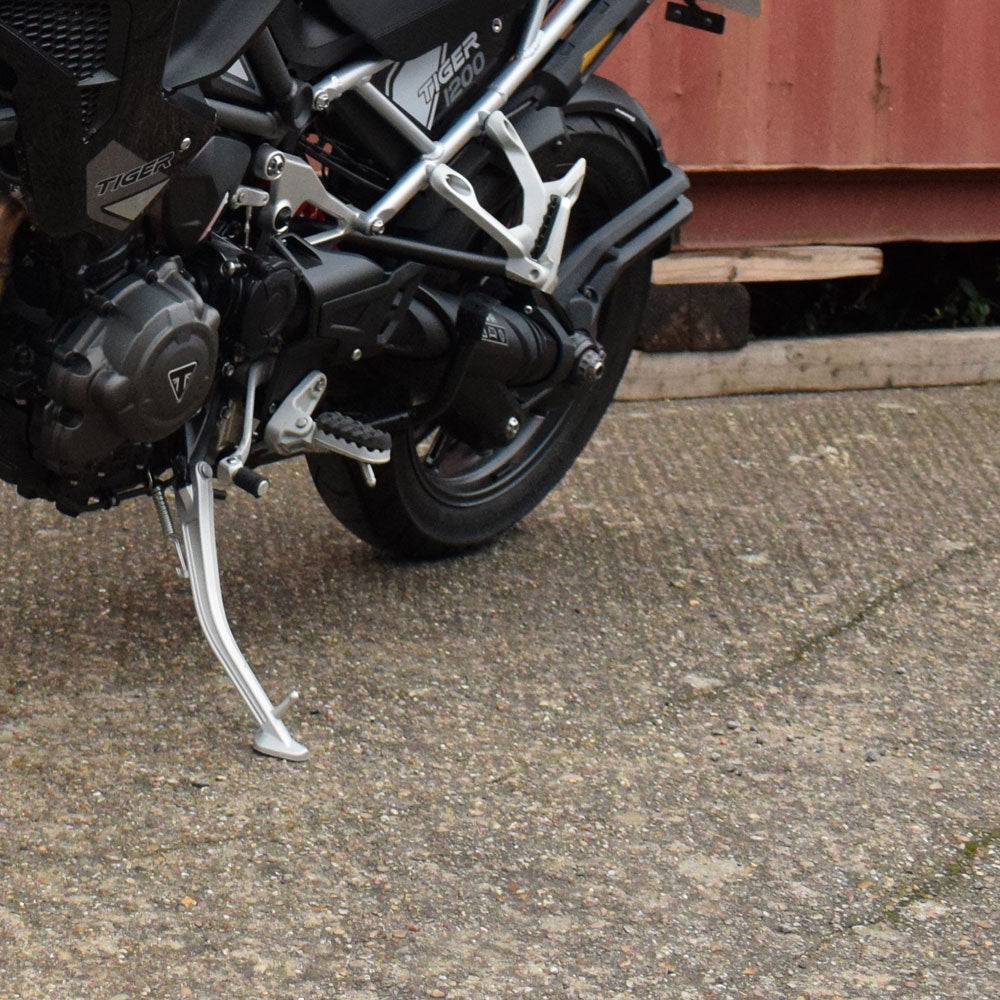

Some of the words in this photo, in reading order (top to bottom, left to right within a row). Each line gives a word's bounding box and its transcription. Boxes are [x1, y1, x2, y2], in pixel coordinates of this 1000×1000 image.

[418, 31, 480, 105] TIGER
[443, 50, 486, 107] 1200
[96, 151, 175, 196] TIGER
